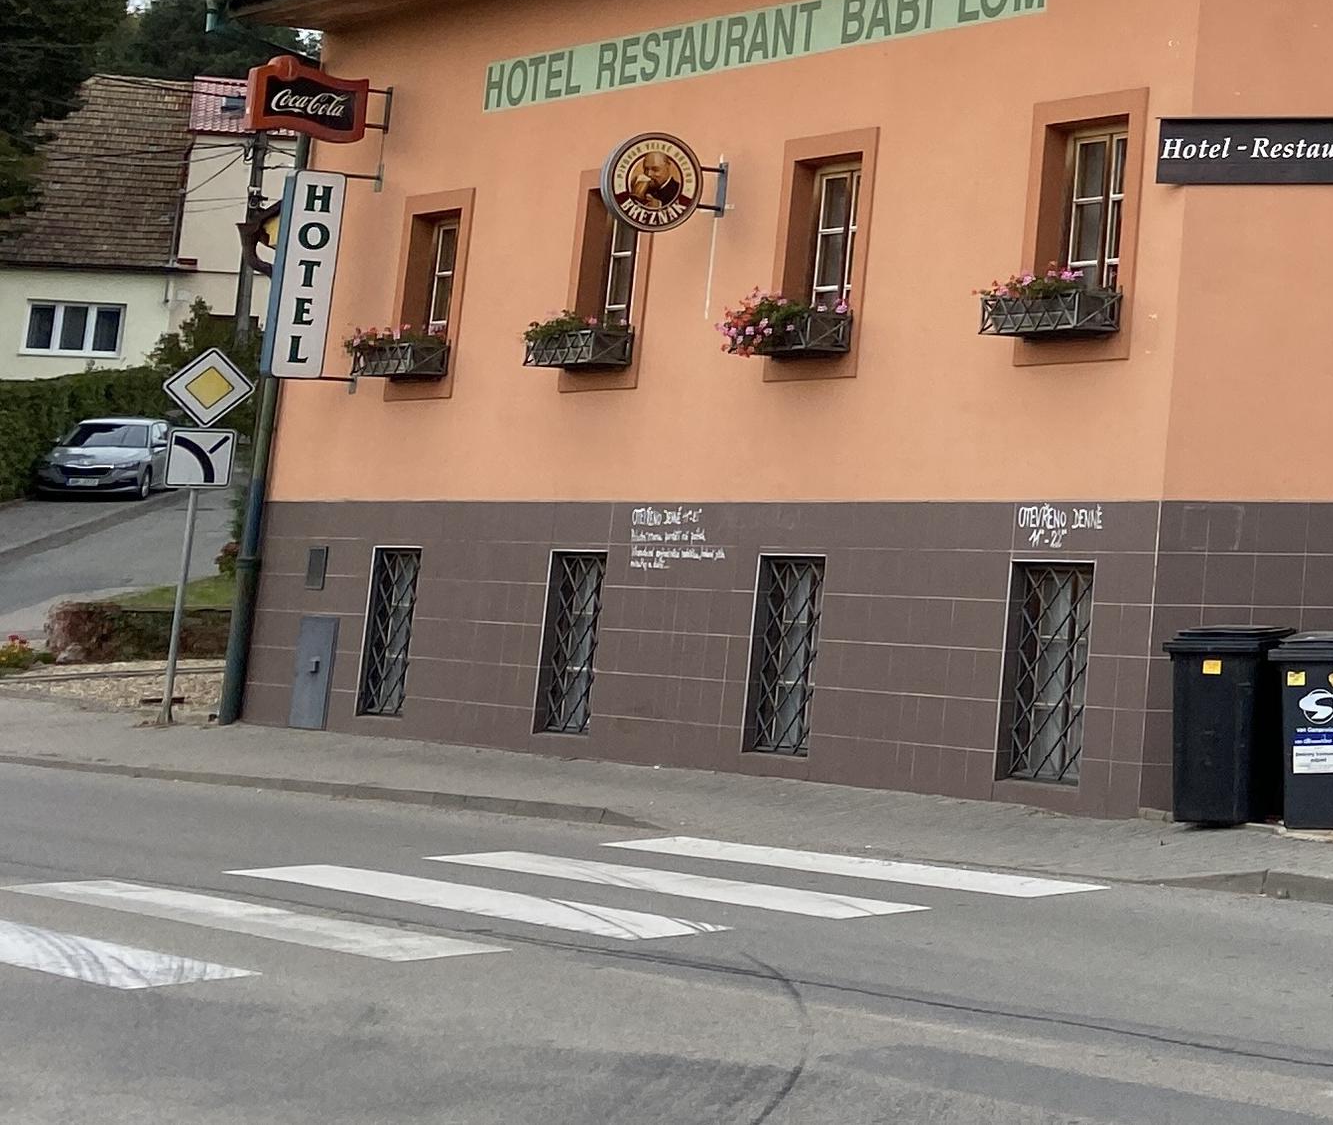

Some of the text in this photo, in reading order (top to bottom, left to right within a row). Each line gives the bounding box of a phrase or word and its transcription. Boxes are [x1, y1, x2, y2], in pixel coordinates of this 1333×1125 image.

[484, 49, 581, 111] HOTEL
[595, 0, 822, 90] RESTAURANT
[271, 88, 347, 117] Coca-Cola
[1160, 137, 1231, 160] Hotel
[286, 184, 333, 364] HOTEL
